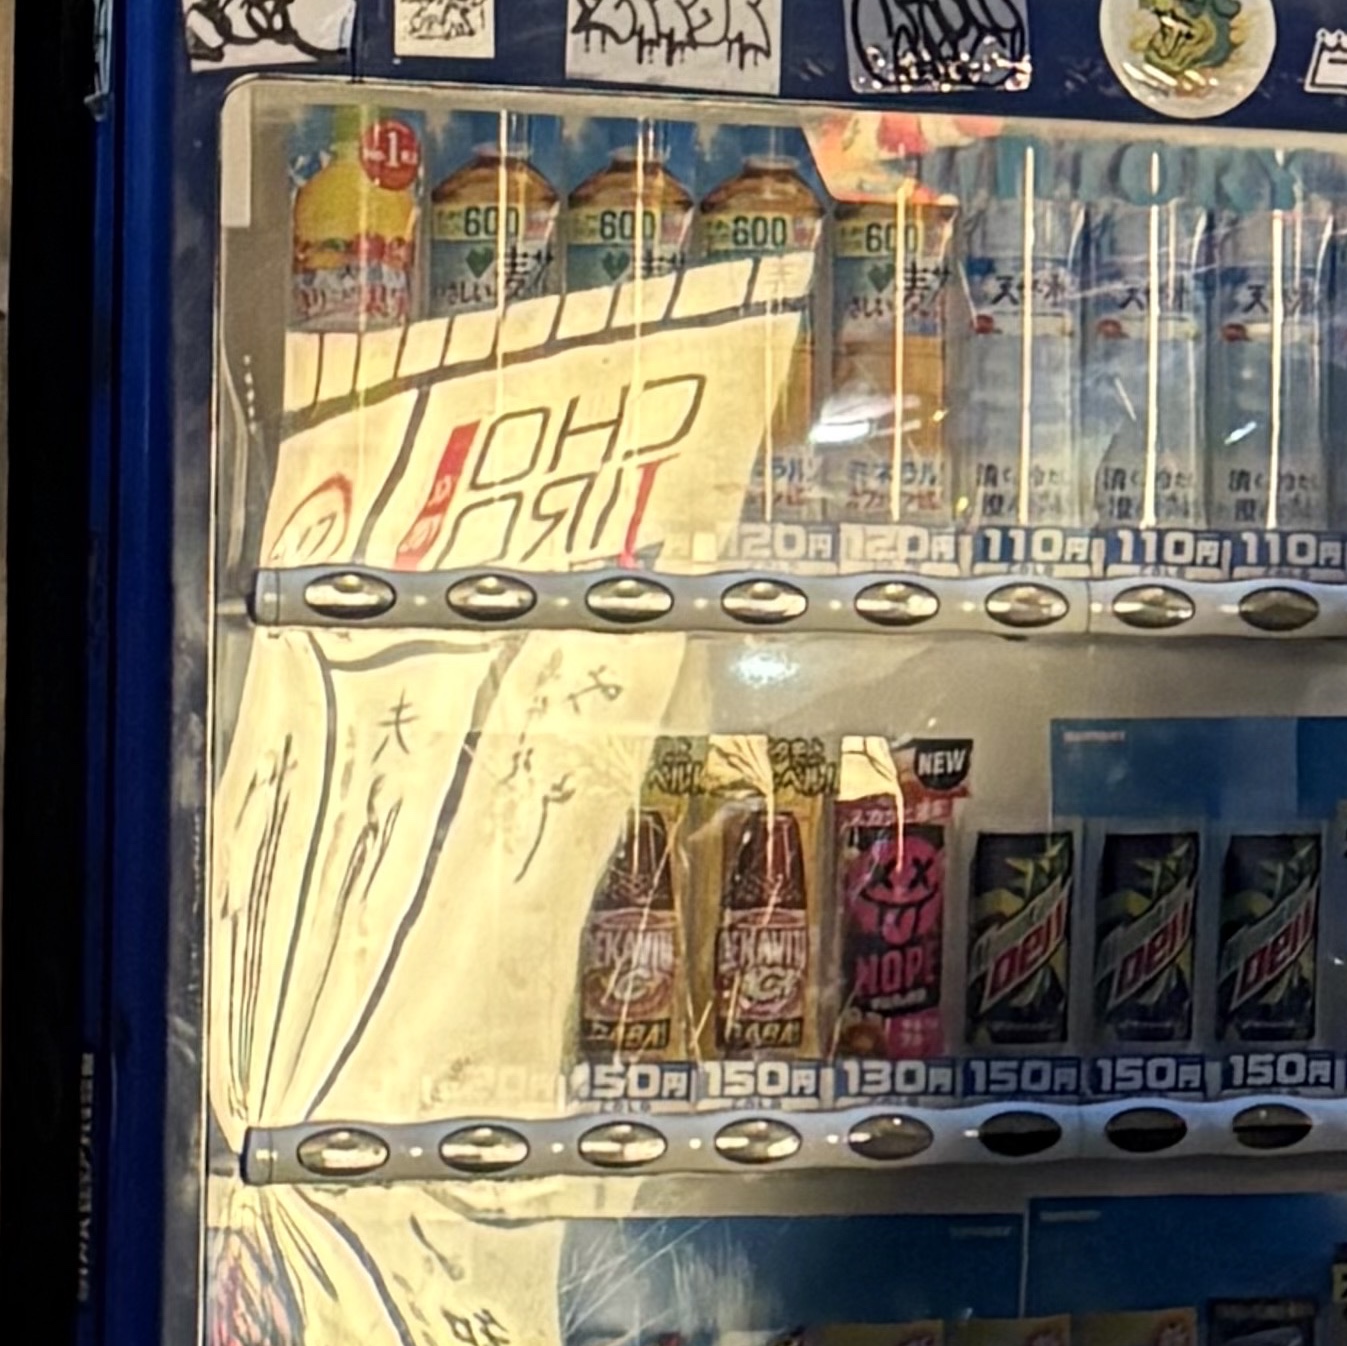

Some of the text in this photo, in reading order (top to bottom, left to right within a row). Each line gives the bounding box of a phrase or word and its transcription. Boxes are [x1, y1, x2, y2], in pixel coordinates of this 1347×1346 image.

[464, 206, 520, 237] 600
[732, 216, 787, 247] 600
[738, 523, 834, 561] 20円
[983, 527, 1091, 562] 110円
[1117, 528, 1221, 564] 110円
[1243, 530, 1343, 566] 110円
[917, 748, 969, 777] NEW
[704, 1061, 820, 1096] 150円
[845, 1060, 955, 1096] 130円
[969, 1058, 1079, 1093] 150円
[1097, 1056, 1201, 1091] 150円
[1228, 1053, 1335, 1087] 150円
